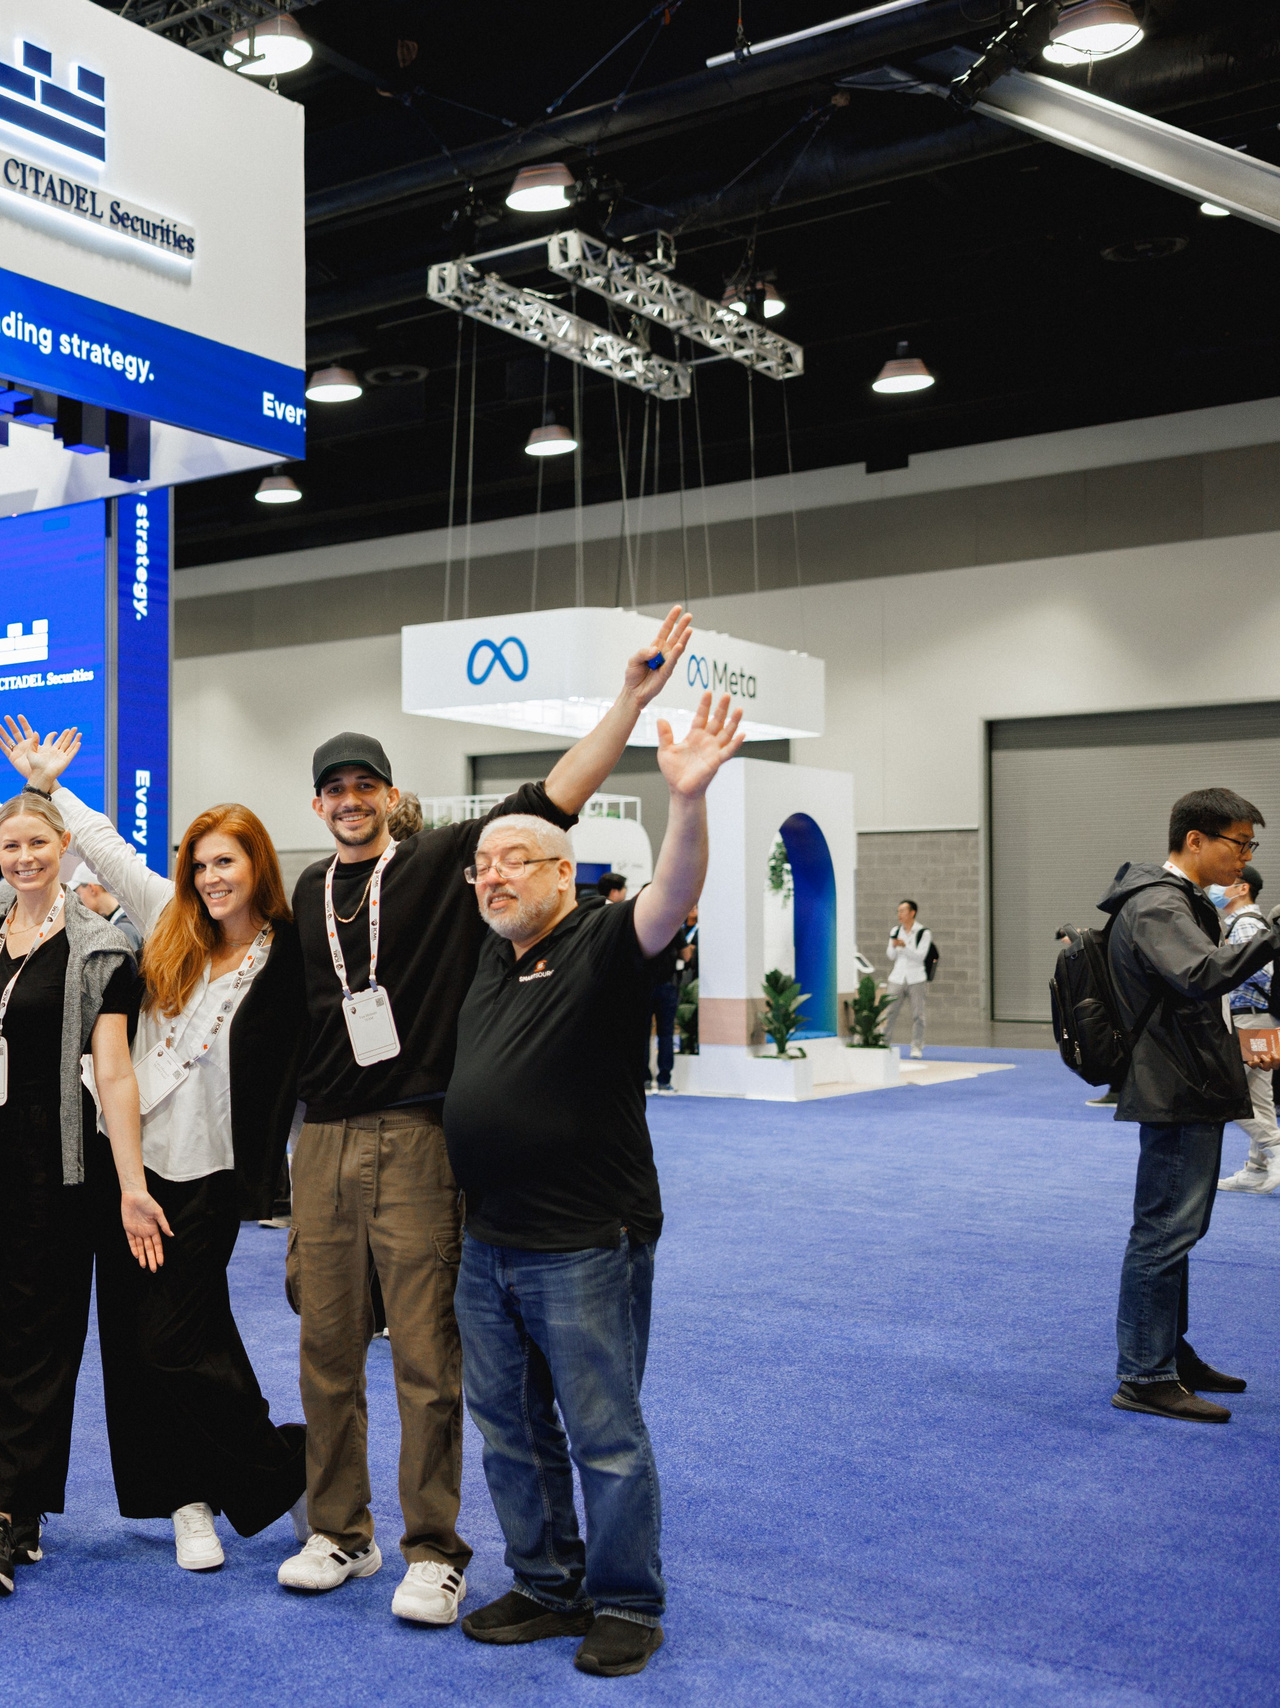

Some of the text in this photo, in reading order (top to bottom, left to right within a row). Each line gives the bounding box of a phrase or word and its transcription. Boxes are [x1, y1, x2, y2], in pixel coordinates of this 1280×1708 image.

[3, 157, 104, 220] CITADEL
[109, 201, 196, 254] Securities
[58, 332, 156, 384] strategy.
[132, 502, 150, 621] strategy.
[45, 668, 95, 686] Securities
[712, 659, 757, 699] Meta
[131, 769, 151, 847] Every
